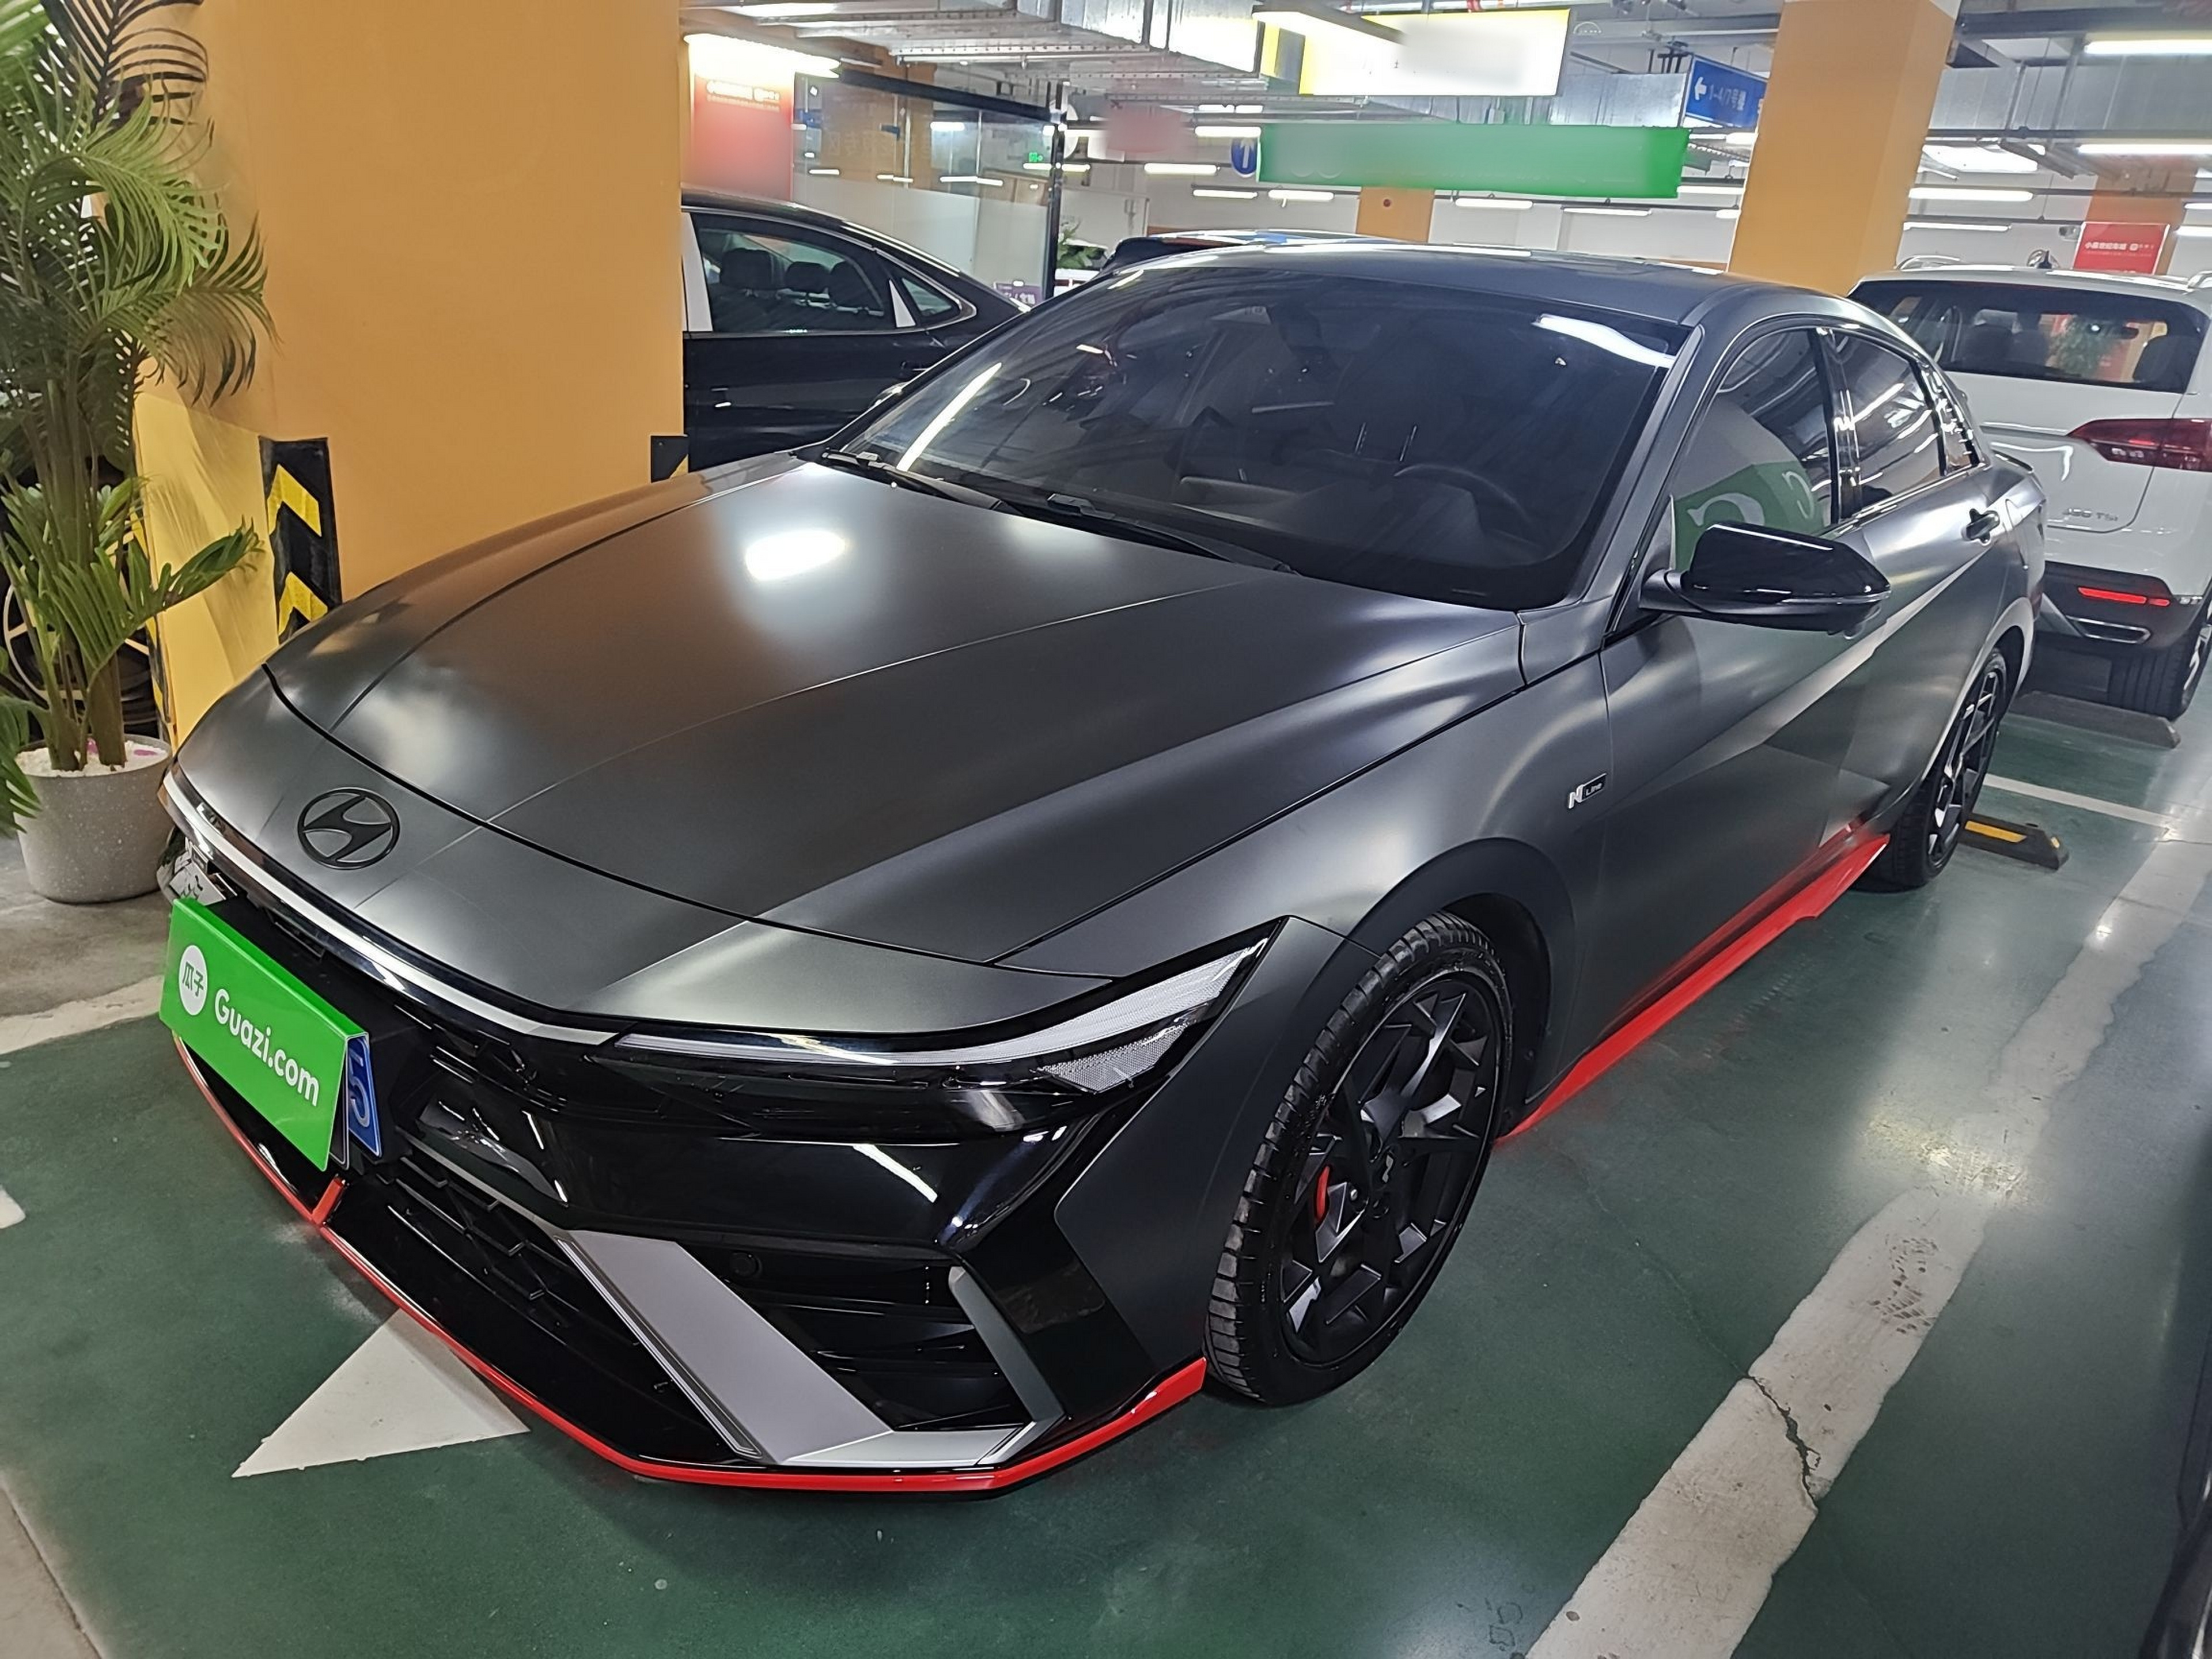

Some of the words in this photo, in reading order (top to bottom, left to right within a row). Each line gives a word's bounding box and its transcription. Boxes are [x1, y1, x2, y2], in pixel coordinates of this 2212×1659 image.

[1568, 784, 1584, 809] N
[1585, 782, 1603, 796] Line
[182, 960, 204, 997] 瓜子
[214, 988, 320, 1107] Guazi.com
